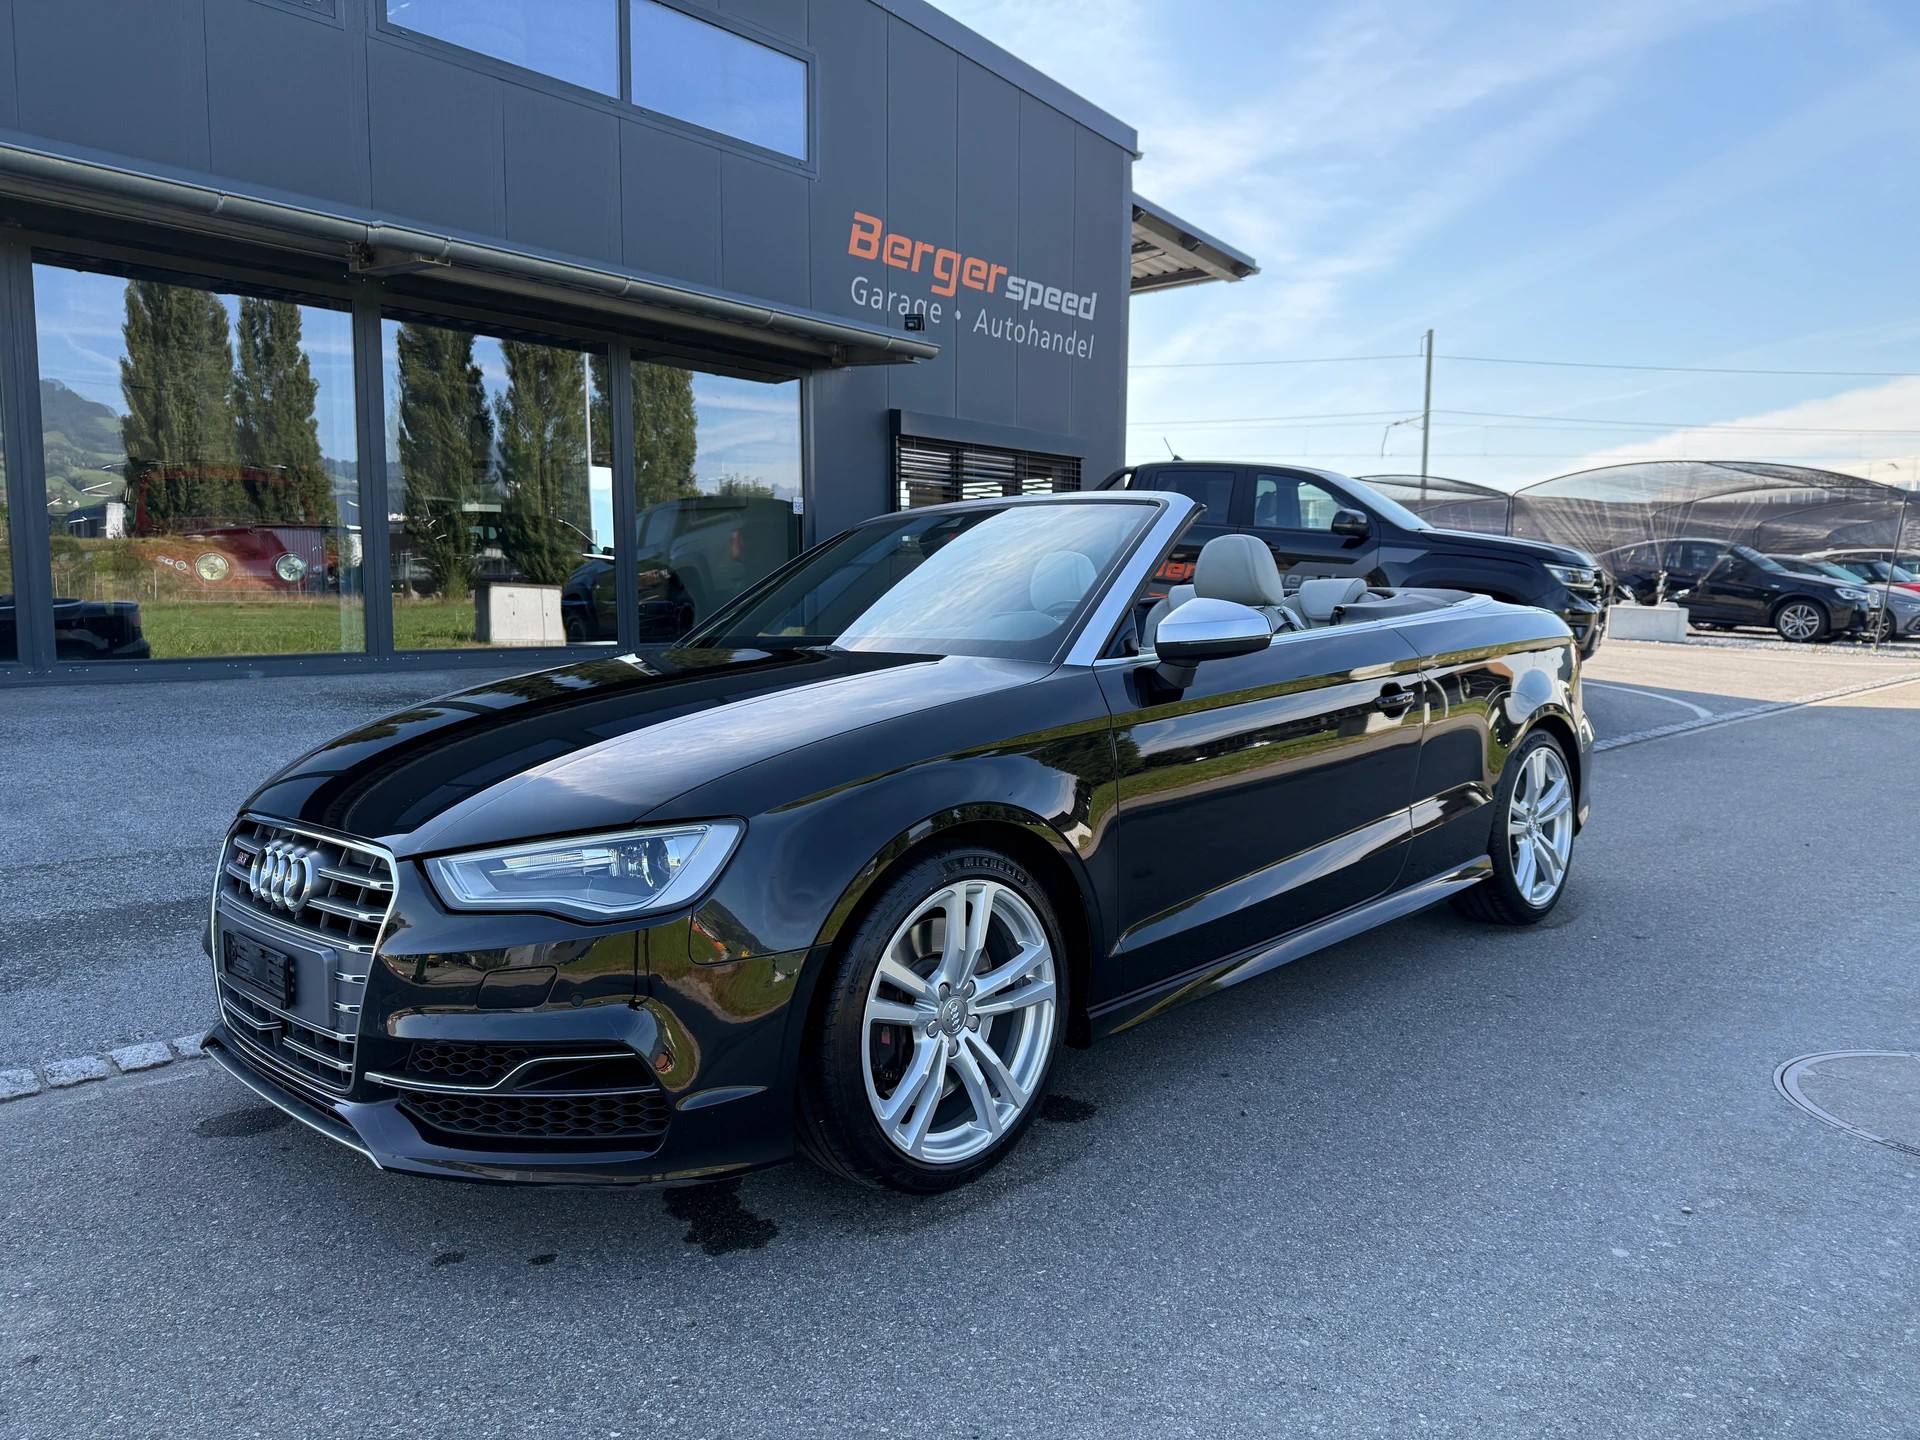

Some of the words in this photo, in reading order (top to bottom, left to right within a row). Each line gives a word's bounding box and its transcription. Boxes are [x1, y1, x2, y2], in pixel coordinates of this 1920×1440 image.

[851, 276, 942, 328] Garage
[973, 308, 1095, 360] Autohandel
[963, 857, 1025, 883] MICHELIN
